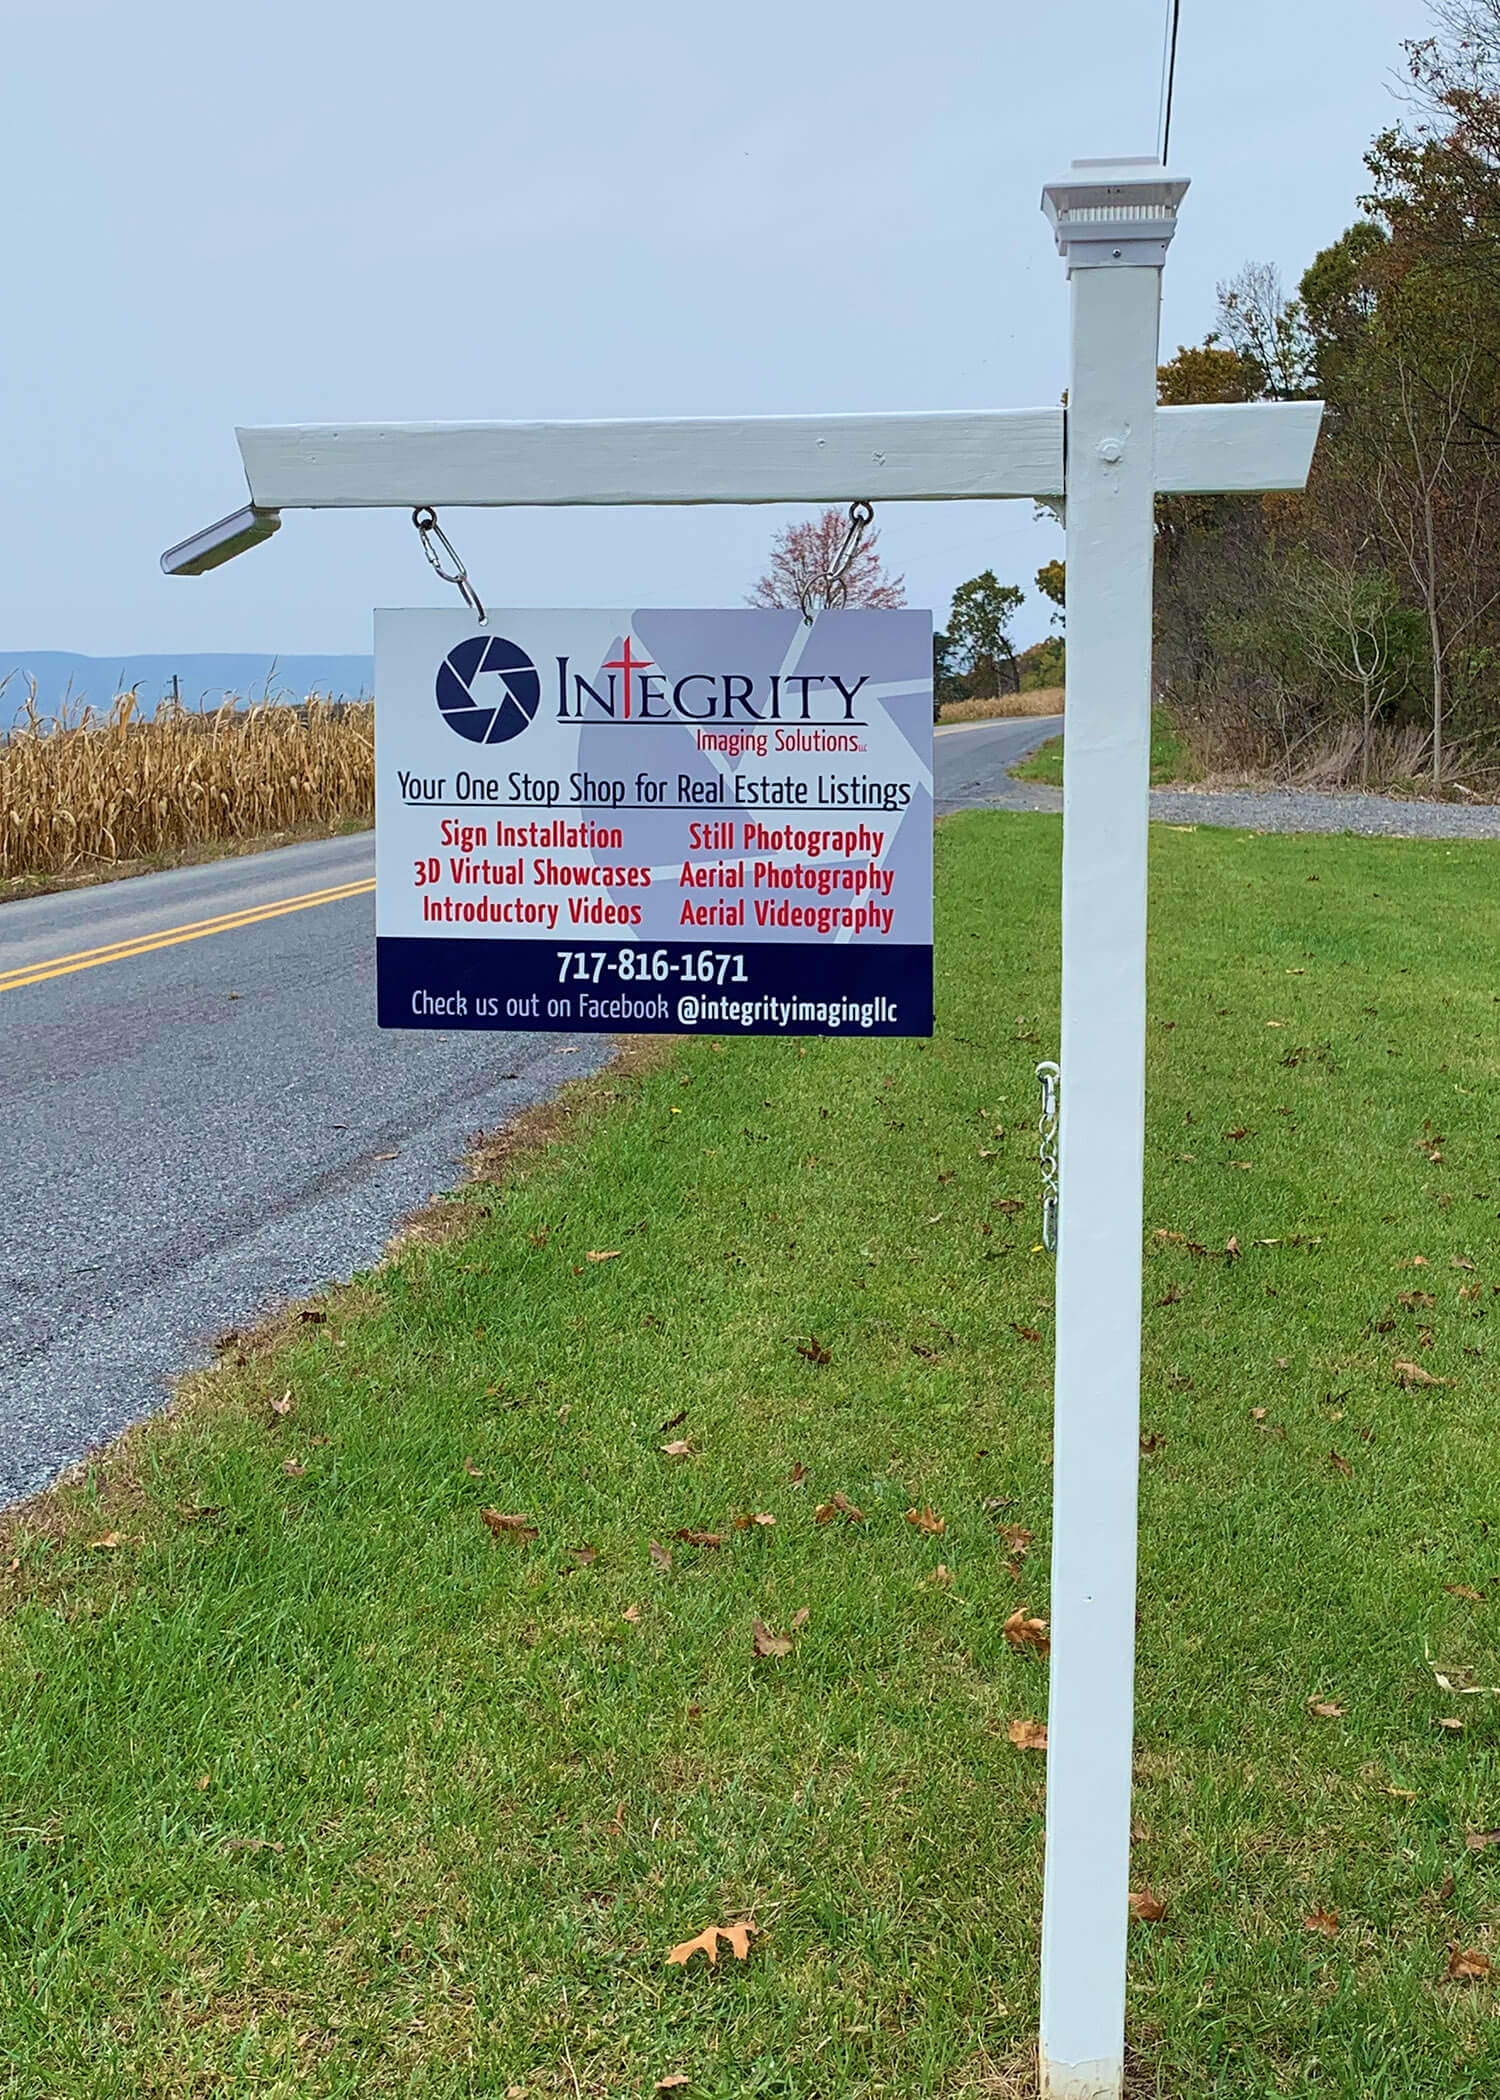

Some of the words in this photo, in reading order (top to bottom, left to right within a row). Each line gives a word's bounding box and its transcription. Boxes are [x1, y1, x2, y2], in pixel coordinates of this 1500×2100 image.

[696, 728, 768, 757] Imaging
[775, 728, 858, 752] Solutions
[398, 770, 446, 802] Your
[456, 772, 498, 801] One
[508, 772, 560, 808] Stop
[570, 773, 626, 809] Shop
[634, 773, 668, 803] for
[677, 774, 725, 804] Real
[734, 775, 808, 805] Estate
[817, 776, 911, 811] Listings
[440, 820, 487, 852] Sign
[496, 821, 623, 849] Installation
[689, 823, 735, 851] Still
[744, 824, 885, 858] Photography
[414, 858, 441, 886] 3D
[450, 859, 525, 887] Virtual
[533, 860, 651, 888] Showcases
[680, 861, 745, 889] Aerial
[754, 862, 894, 896] Photography
[423, 895, 559, 929] Introductory
[568, 897, 642, 925] Videos
[680, 899, 745, 927] Aerial
[753, 899, 894, 934] Videography
[557, 949, 748, 985] 717-816-1671
[411, 990, 467, 1017] Check
[475, 996, 498, 1016] us
[505, 994, 540, 1018] out
[547, 998, 571, 1018] on
[578, 993, 669, 1020] Facebook
[677, 995, 898, 1028] @integrityimagingllc
